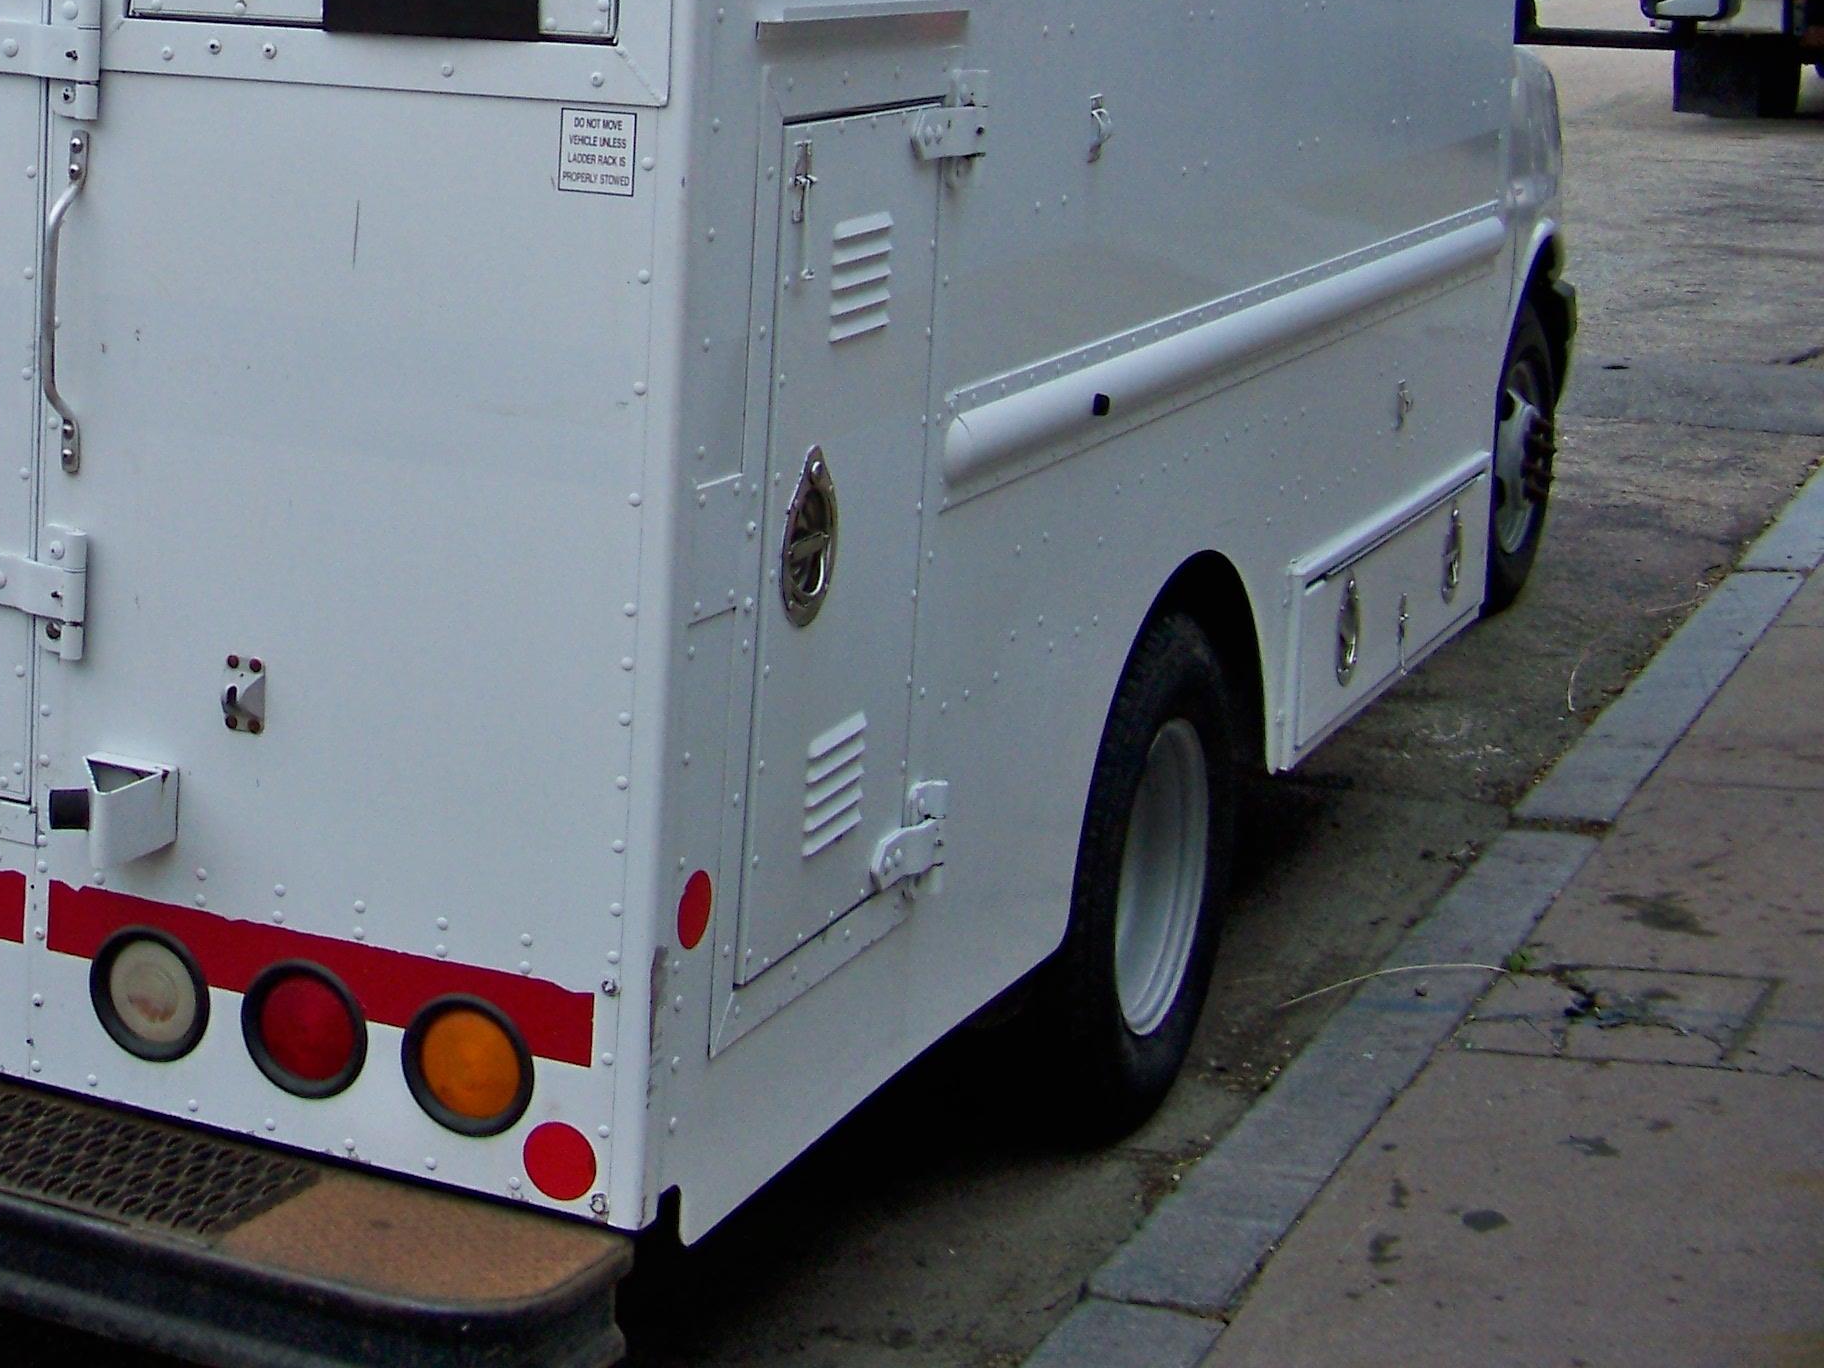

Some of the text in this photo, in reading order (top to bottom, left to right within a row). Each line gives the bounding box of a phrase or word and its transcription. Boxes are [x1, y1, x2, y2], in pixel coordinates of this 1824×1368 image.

[574, 117, 623, 130] DO NOT MOVE
[570, 135, 627, 149] VEHICLE UNLESS
[568, 153, 626, 167] LADDER RACK IS
[562, 171, 630, 186] PROPERLY STOWED
